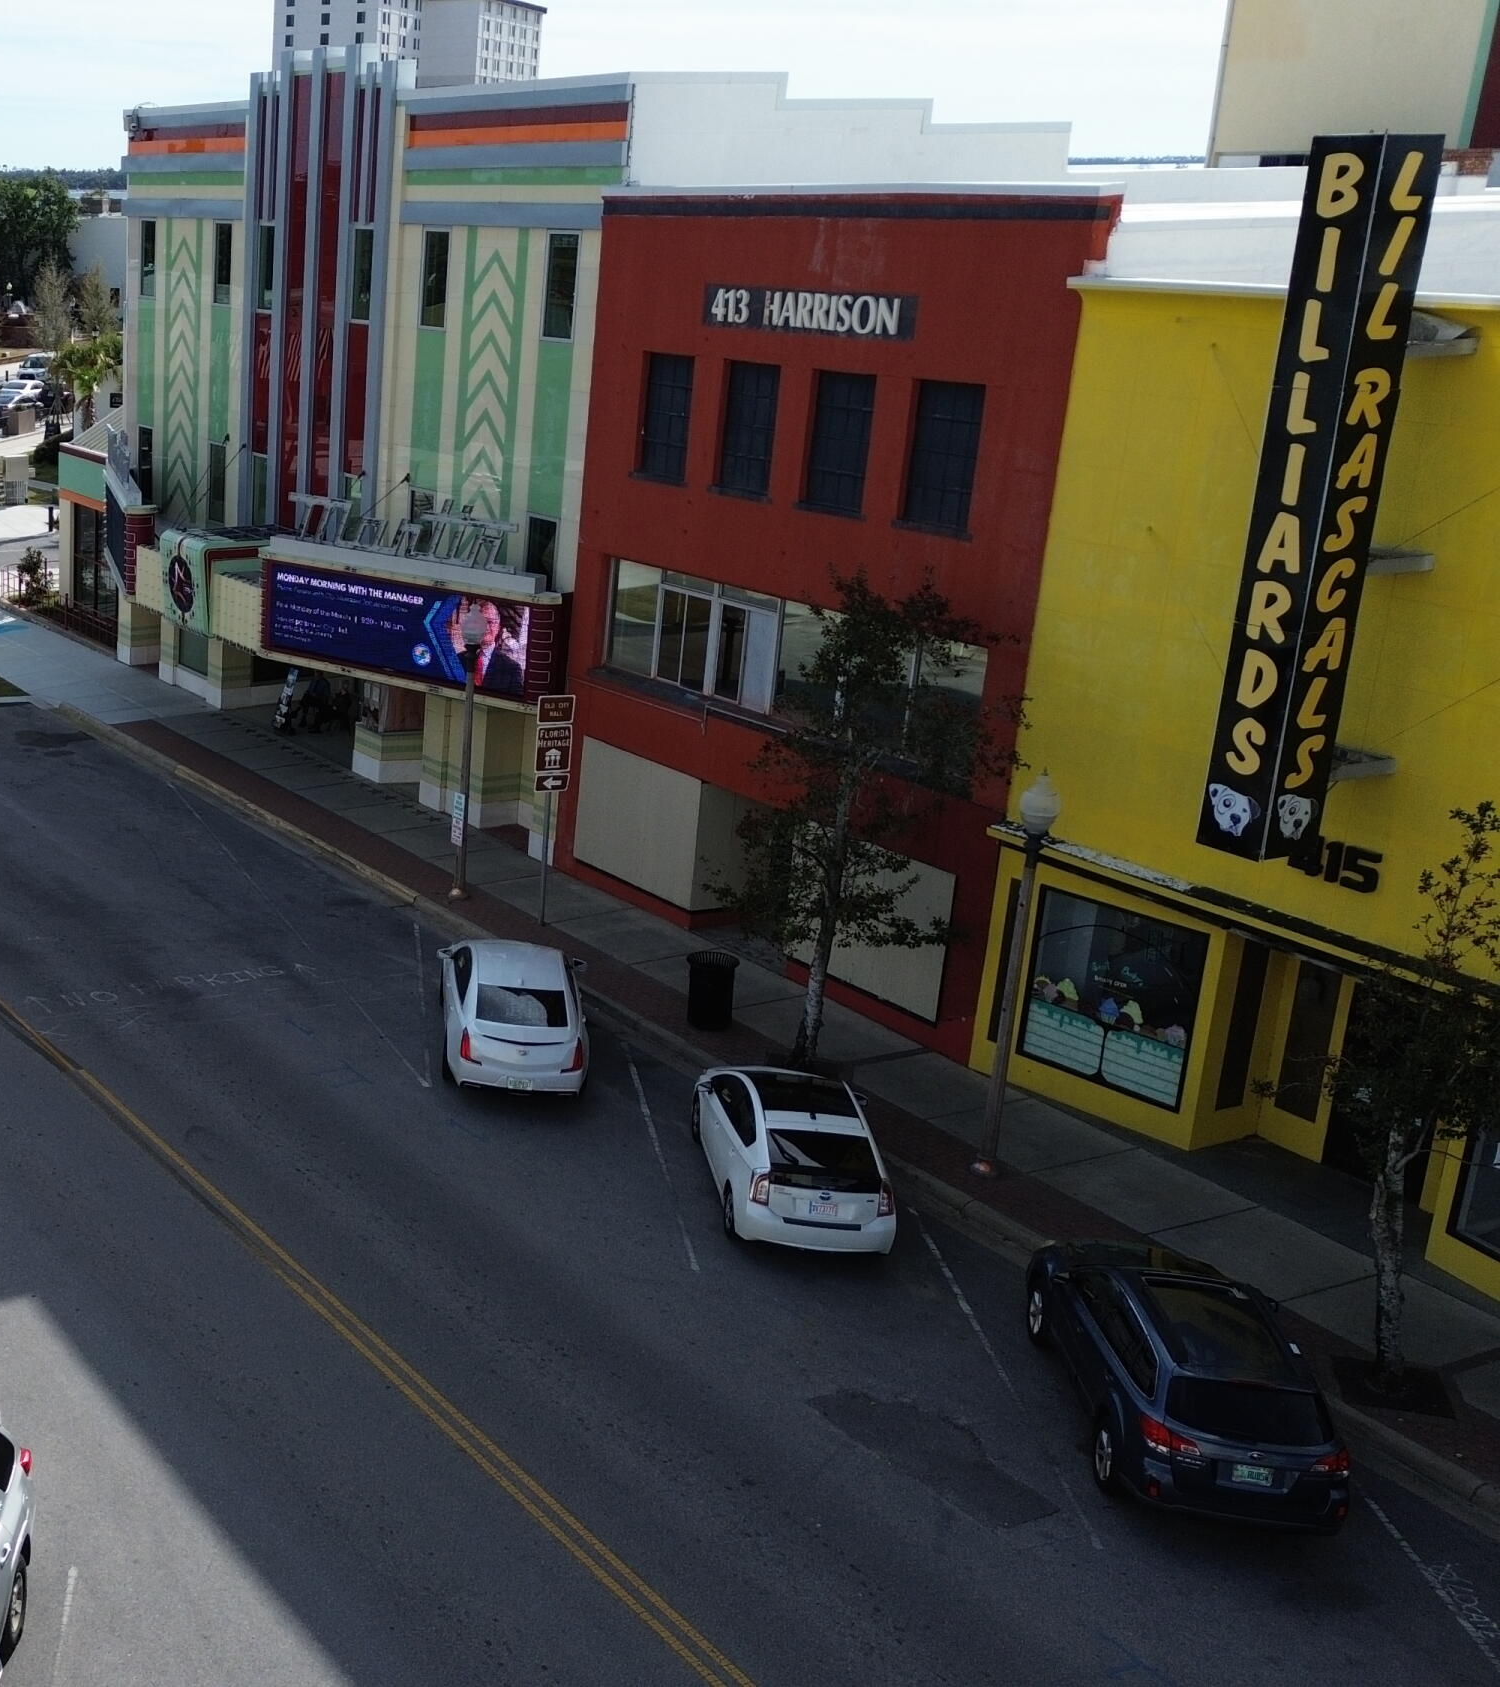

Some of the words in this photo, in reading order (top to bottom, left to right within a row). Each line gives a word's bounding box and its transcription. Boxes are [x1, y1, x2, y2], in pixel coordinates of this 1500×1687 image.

[1365, 150, 1425, 341] LIL
[710, 287, 751, 324] 413
[762, 290, 902, 336] HARRISON
[1225, 151, 1365, 776] BILLIARDS
[276, 571, 310, 586] MONDAY
[310, 576, 347, 593] MORNING
[347, 583, 368, 597] WITH
[368, 587, 383, 599] THE
[383, 591, 424, 606] MANAGER
[1284, 366, 1392, 790] RASCALS
[538, 738, 571, 748] HERITAGE
[540, 728, 570, 738] FLORIDA
[1287, 834, 1384, 894] 415
[59, 990, 119, 1008] NO
